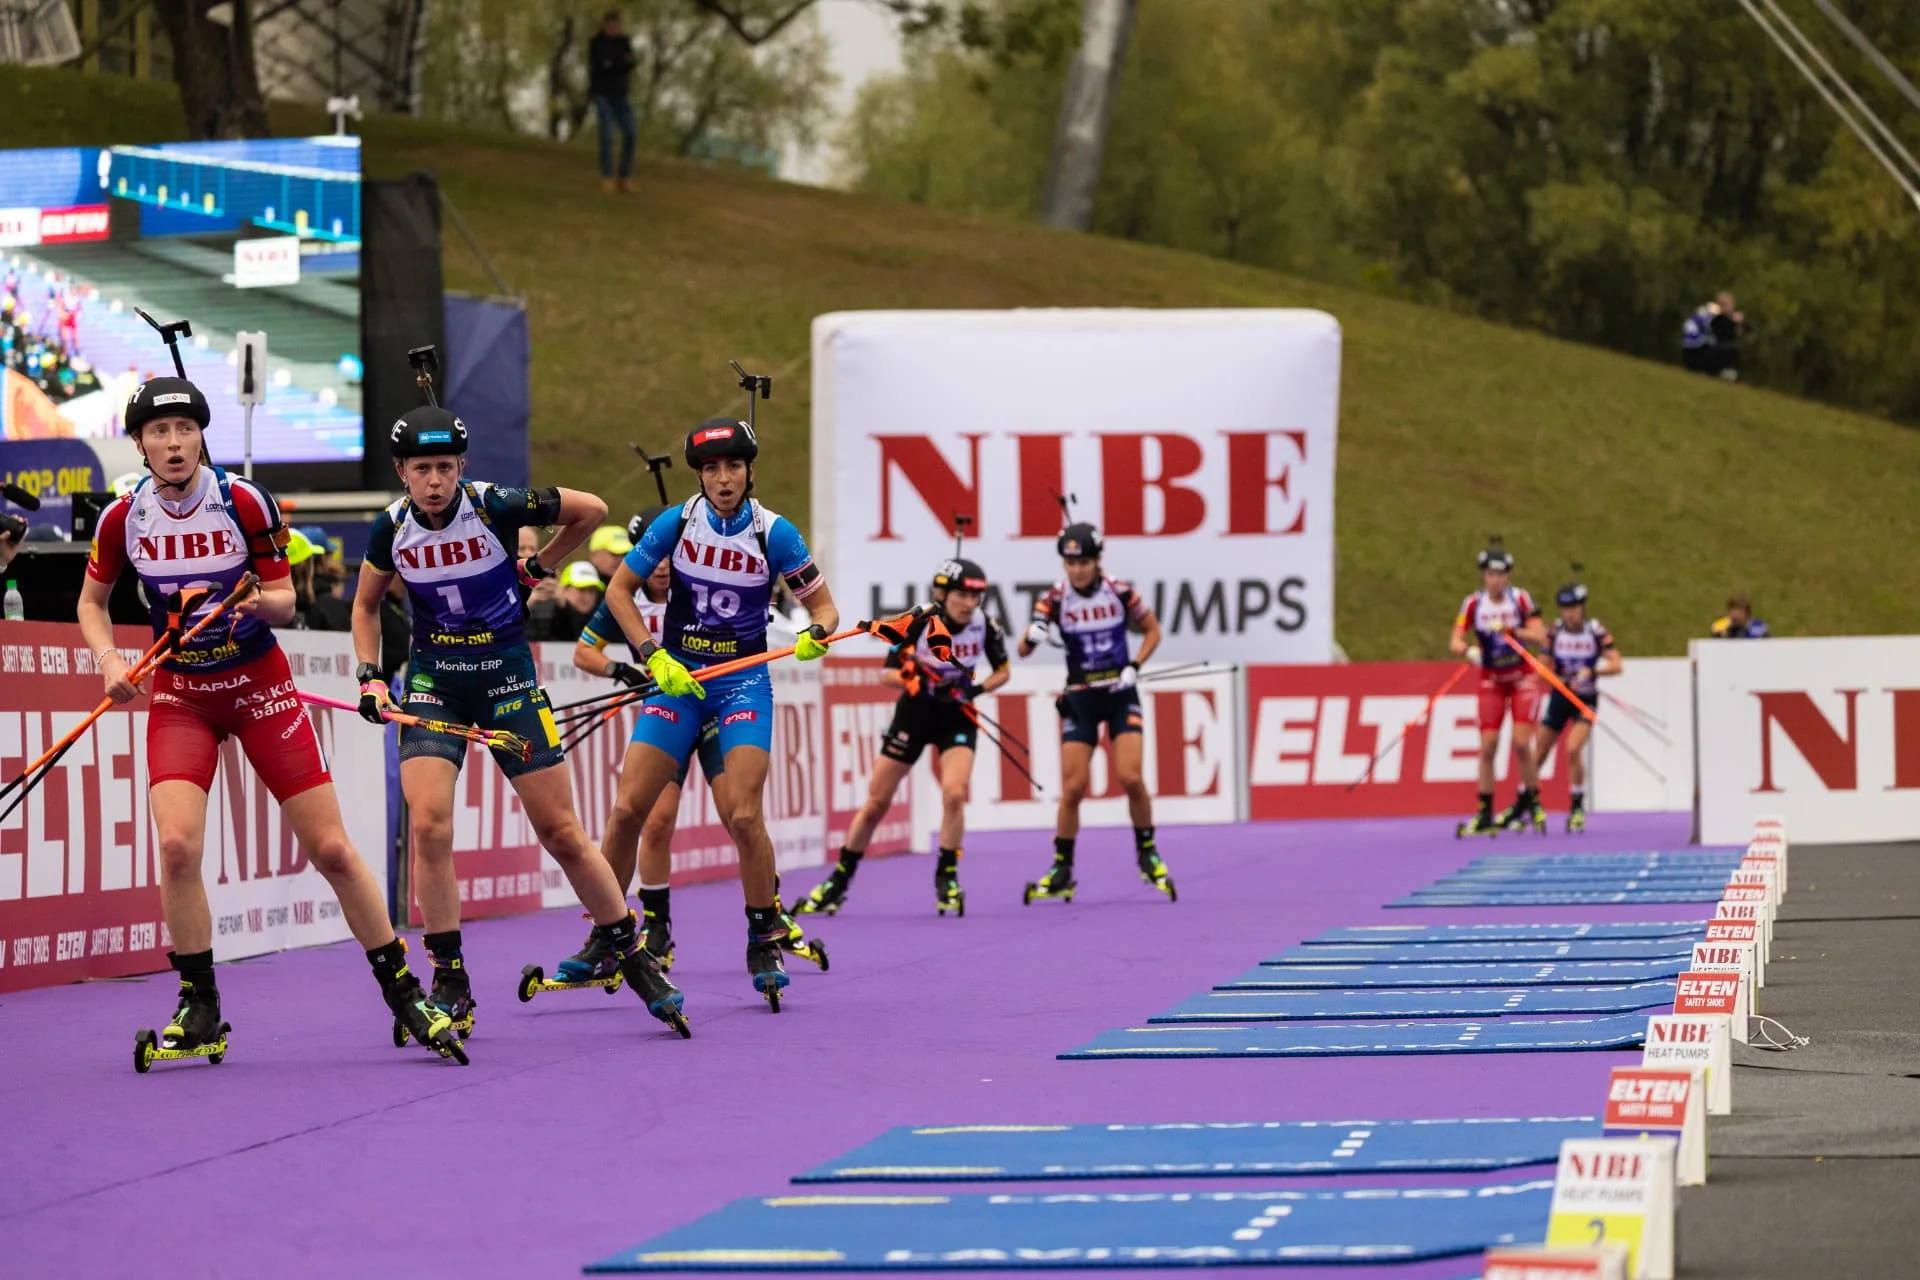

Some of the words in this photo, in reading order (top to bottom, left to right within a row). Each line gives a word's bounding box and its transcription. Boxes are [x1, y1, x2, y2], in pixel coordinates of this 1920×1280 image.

[866, 430, 1308, 541] NIBE
[138, 529, 238, 561] NIBE
[397, 536, 492, 570] NIBE
[679, 538, 765, 574] NIBE
[436, 584, 465, 615] 1
[691, 582, 740, 618] 10
[870, 583, 1048, 642] HAT
[1064, 603, 1119, 624] NIBE
[681, 634, 711, 651] LOOP
[712, 640, 738, 654] ONE
[41, 646, 69, 674] ELTEN
[435, 660, 479, 672] Monitor
[481, 659, 503, 670] ERP
[188, 674, 252, 692] LAPUA
[487, 679, 536, 698] SVEASKOG
[495, 699, 523, 717] ATG
[644, 706, 675, 721] enel
[724, 711, 753, 725] enel
[280, 708, 306, 740] CRAFT
[928, 690, 1222, 803] IBE
[1251, 695, 1558, 785] ELTE
[1725, 888, 1765, 900] ELTEN
[293, 900, 313, 925] NIBE
[1719, 905, 1757, 918] NIBE
[1706, 925, 1755, 938] ELTEN
[13, 937, 32, 967] SAFETY
[33, 935, 50, 963] SHOES
[56, 930, 87, 962] ELTEN
[91, 928, 109, 957] SAFETY
[108, 926, 125, 954] SHOES
[129, 921, 157, 951] ELTEN
[1694, 948, 1742, 964] NIBE
[1679, 980, 1737, 996] ELTEN
[1684, 997, 1705, 1007] SAFETY
[1706, 998, 1725, 1007] SHOES
[1650, 1023, 1712, 1043] NIBE
[1647, 1047, 1672, 1058] HEAT
[1674, 1047, 1709, 1060] PUMPS
[1610, 1078, 1690, 1101] ELTEN
[1567, 1151, 1644, 1181] NIBE
[1560, 1186, 1593, 1200] HEAT
[1597, 1187, 1644, 1203] PUMPS
